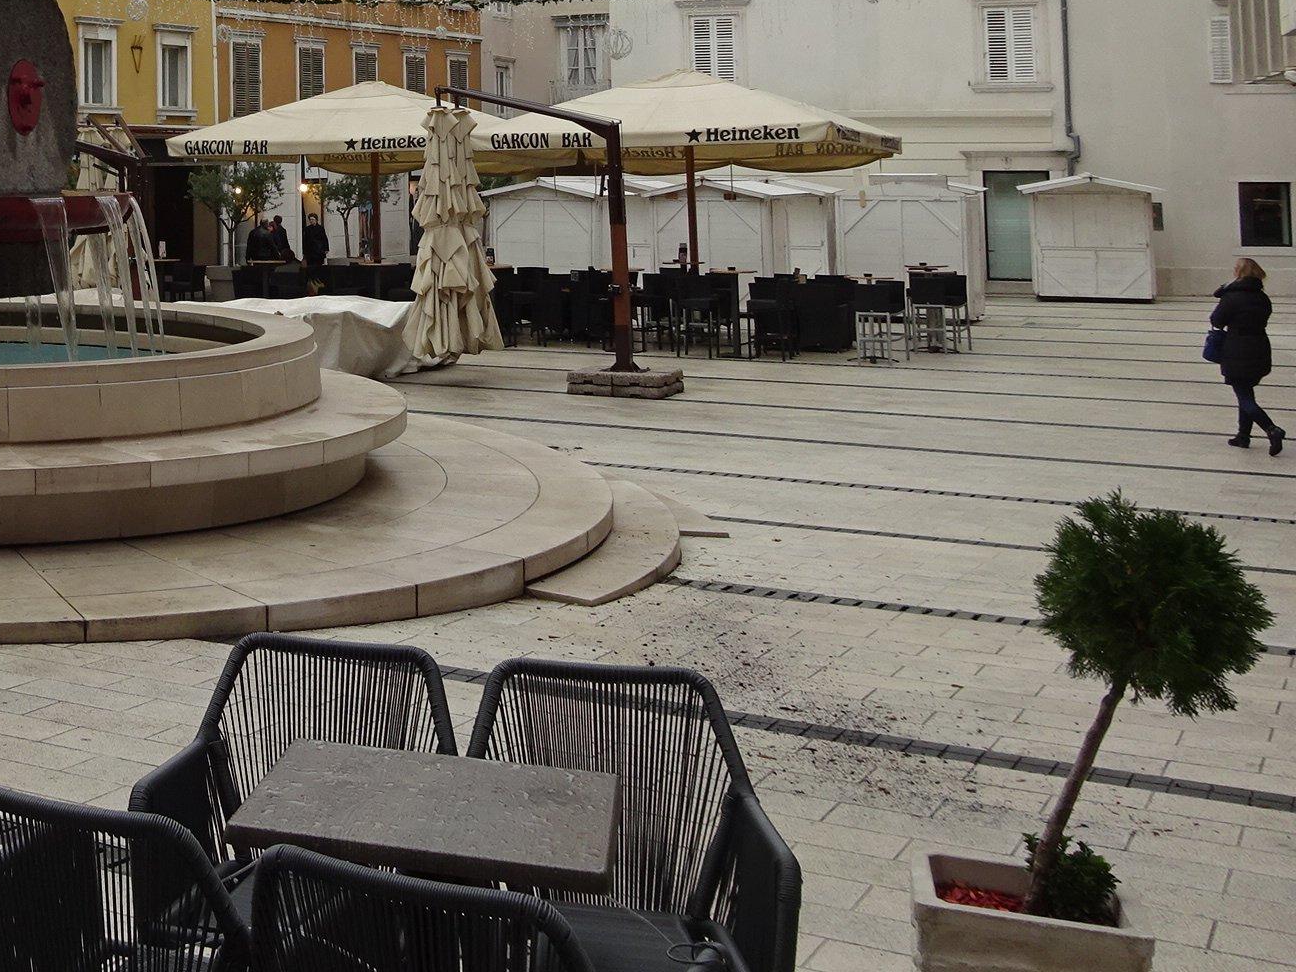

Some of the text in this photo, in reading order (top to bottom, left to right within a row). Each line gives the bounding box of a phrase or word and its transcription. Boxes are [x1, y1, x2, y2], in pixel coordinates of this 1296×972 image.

[491, 132, 593, 149] GARCON BAR
[705, 126, 800, 143] Heineken
[184, 139, 269, 155] GARCON BAR
[360, 136, 427, 151] Heineke
